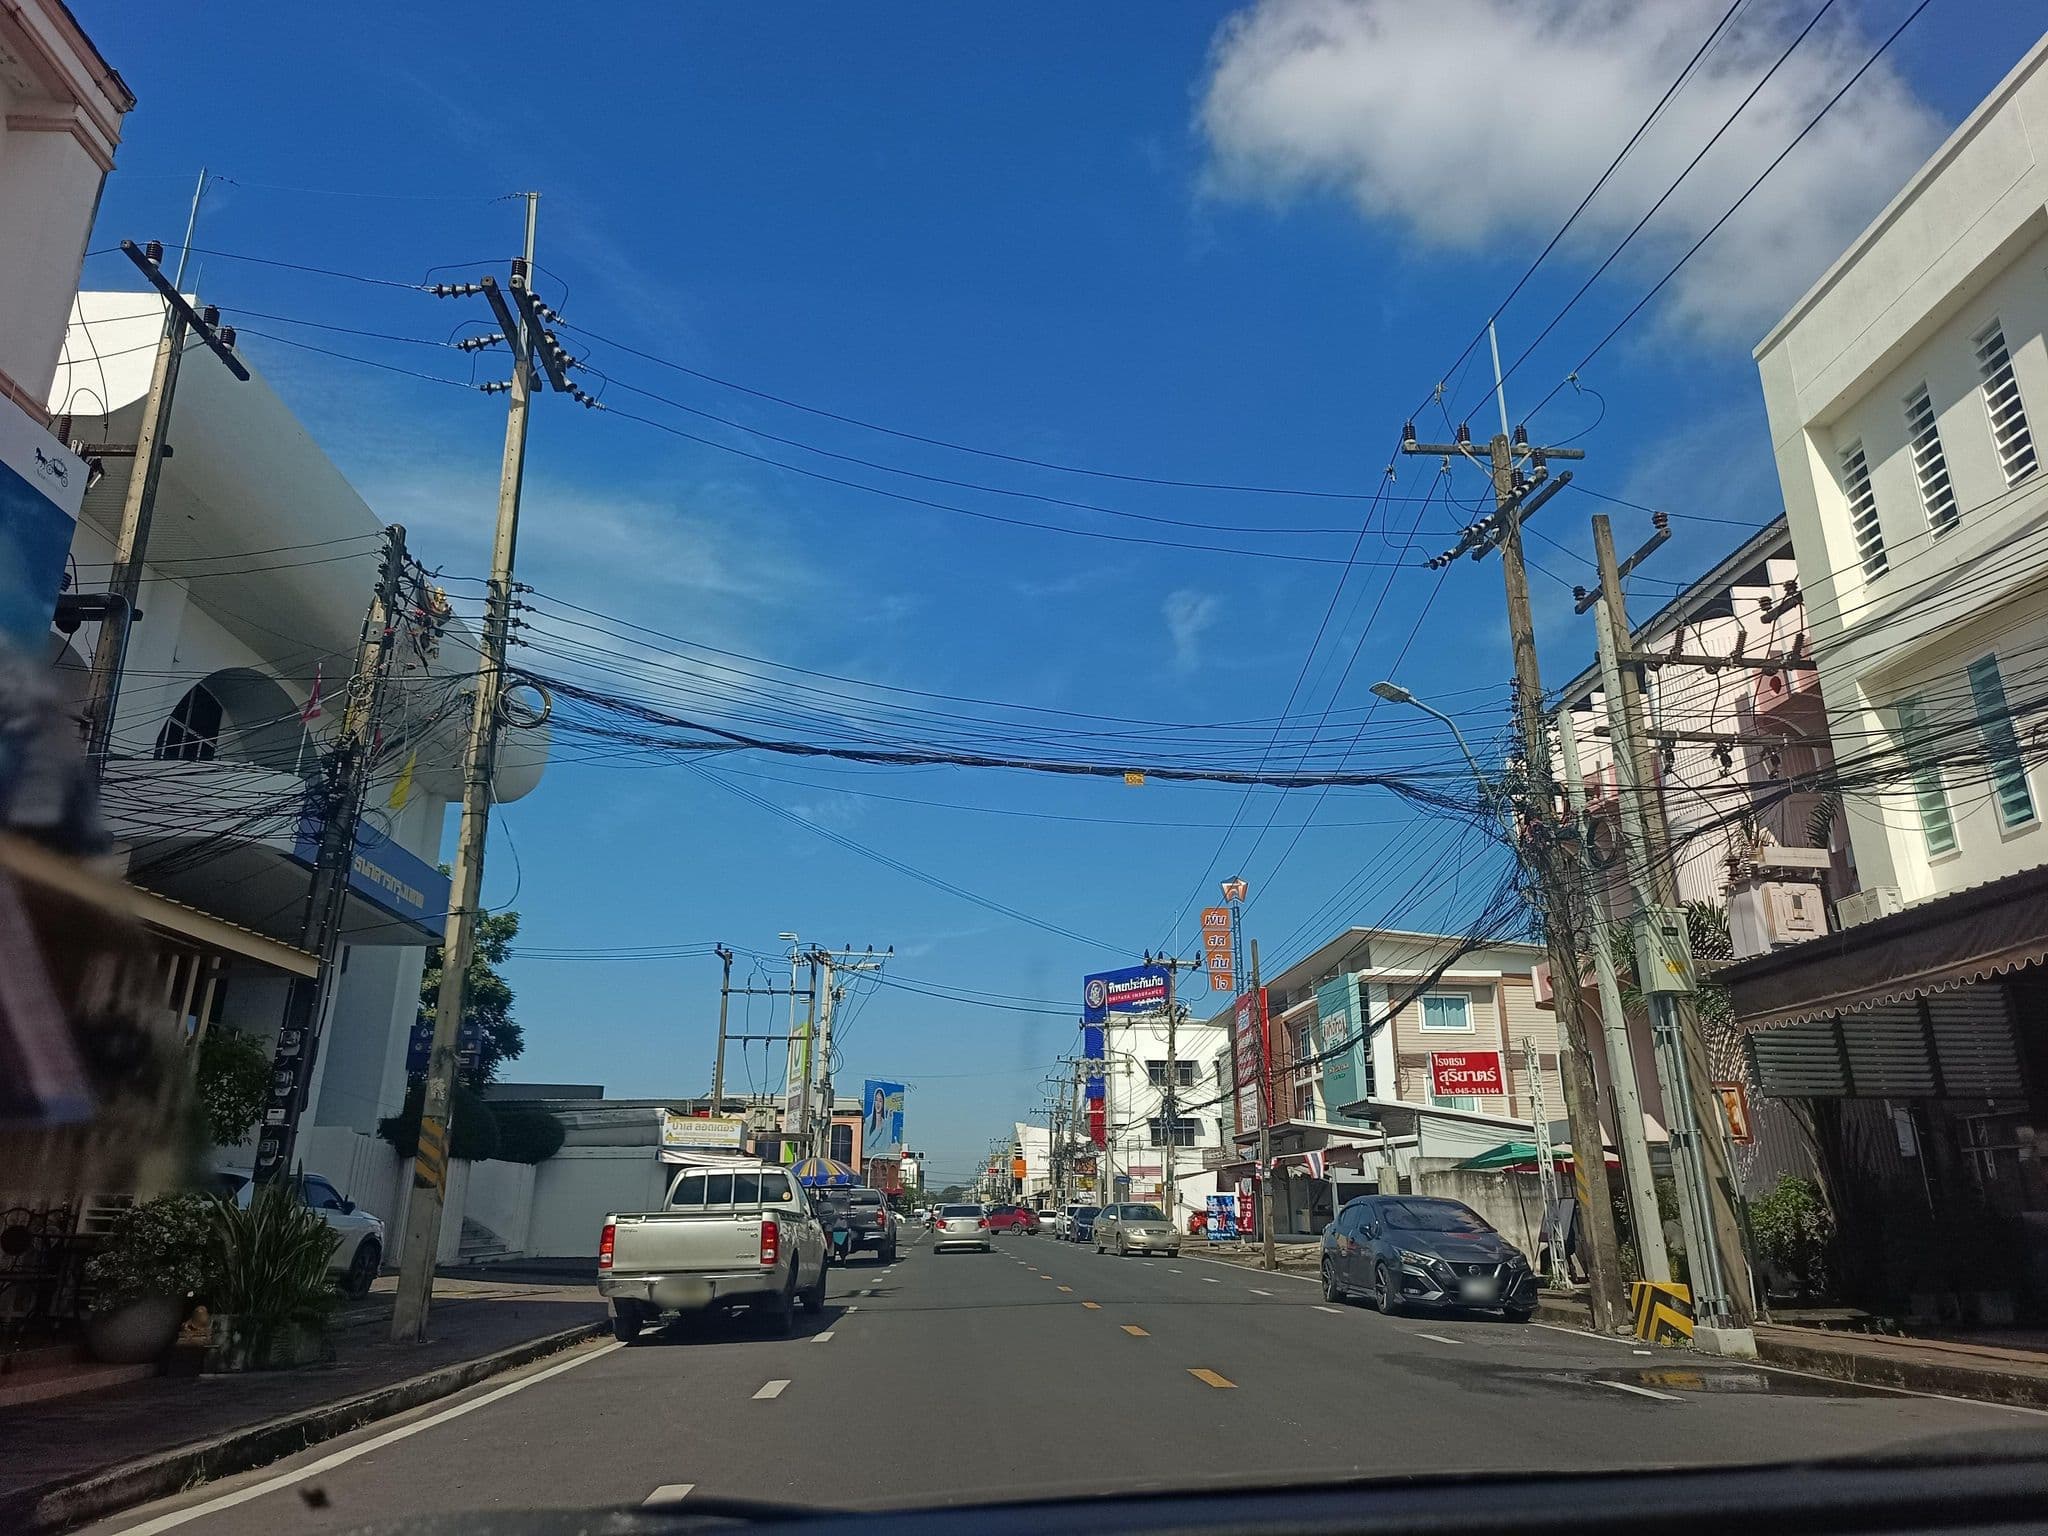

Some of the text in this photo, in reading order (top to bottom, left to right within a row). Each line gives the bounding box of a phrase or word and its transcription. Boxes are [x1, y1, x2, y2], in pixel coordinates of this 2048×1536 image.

[1208, 935, 1226, 946] สด
[1108, 975, 1163, 993] ทิพยประกันภัย
[1433, 1054, 1466, 1067] โรงแรม
[1439, 1067, 1497, 1086] สุริยาตร์
